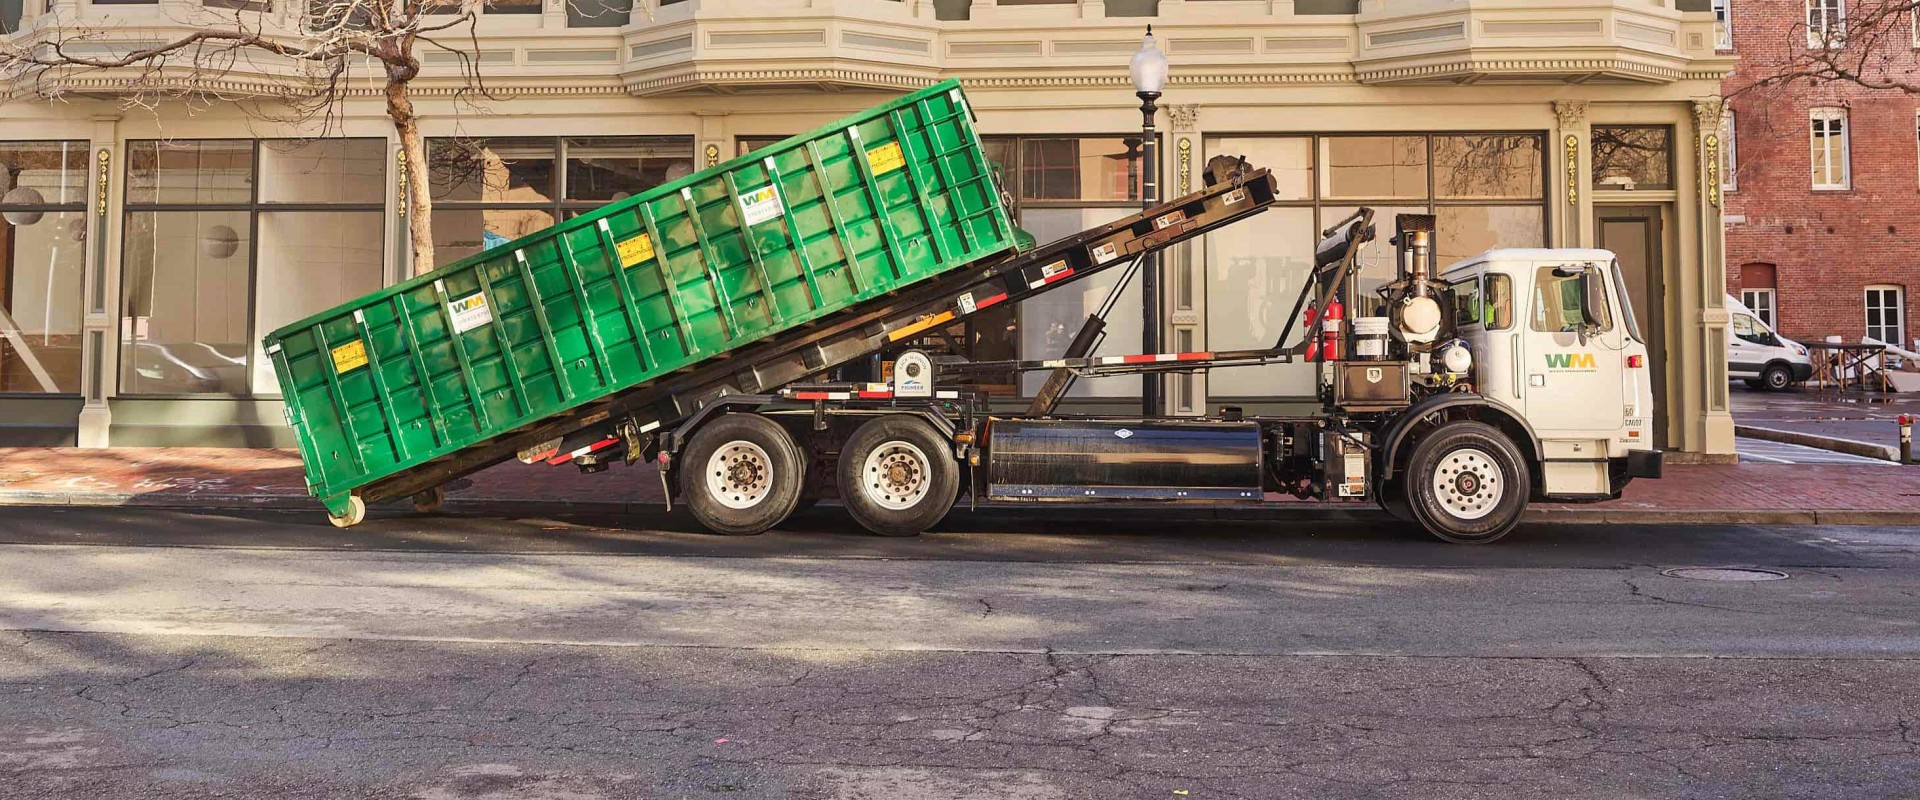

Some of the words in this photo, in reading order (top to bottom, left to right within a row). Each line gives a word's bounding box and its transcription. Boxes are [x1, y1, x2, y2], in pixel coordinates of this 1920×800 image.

[743, 187, 776, 206] WM
[452, 295, 484, 314] WM
[1545, 353, 1596, 368] WM
